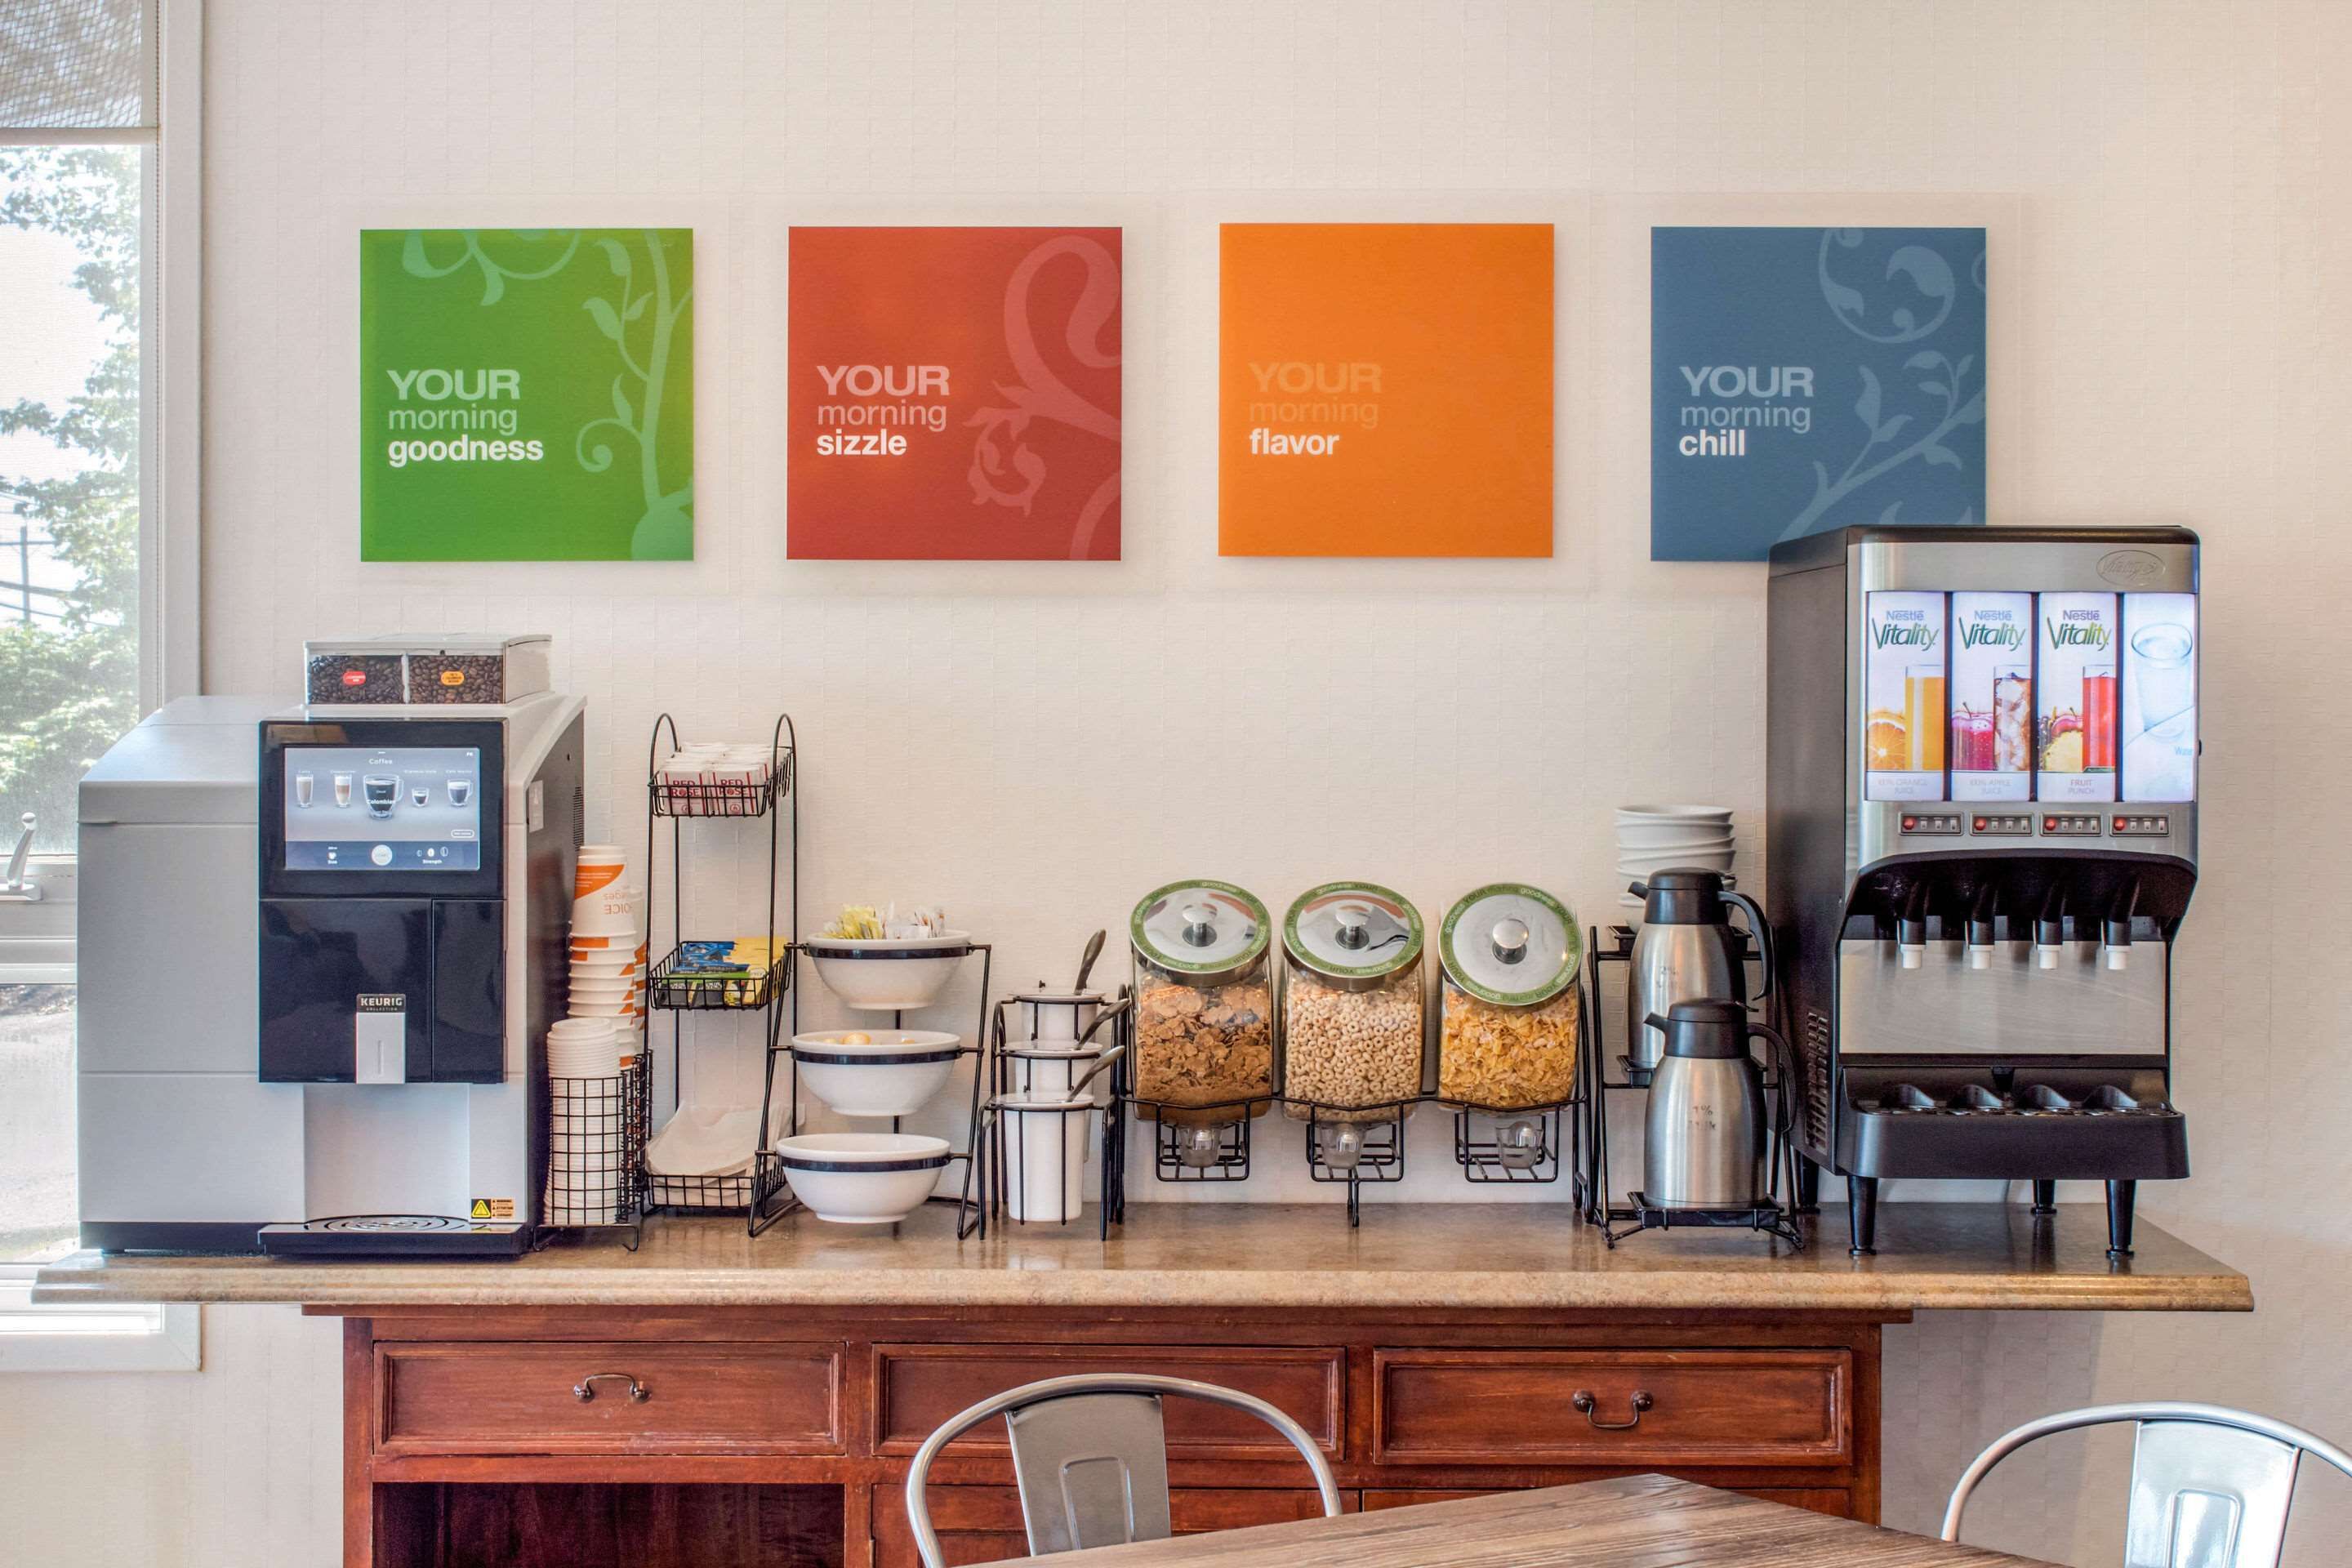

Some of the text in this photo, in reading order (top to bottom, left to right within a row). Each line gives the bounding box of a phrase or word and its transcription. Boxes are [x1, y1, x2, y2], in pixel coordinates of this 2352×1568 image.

[386, 368, 520, 401] YOUR
[817, 365, 950, 397] YOUR
[1248, 362, 1382, 394] YOUR
[1679, 366, 1814, 398] YOUR
[388, 403, 517, 436] morning
[817, 399, 947, 432] morning
[1250, 395, 1379, 430] morning
[1681, 400, 1811, 434] morning
[388, 434, 544, 468] goodness
[817, 428, 907, 456] sizzle
[1250, 427, 1340, 456] flavor
[1679, 429, 1745, 457] chill
[1872, 617, 1939, 652] Vitality
[1958, 617, 2026, 652] Vitality
[2047, 617, 2111, 652] Vitality
[720, 778, 743, 787] RED
[604, 902, 633, 915] OICE
[1521, 887, 1556, 906] goodness
[360, 997, 403, 1006] KEURIG
